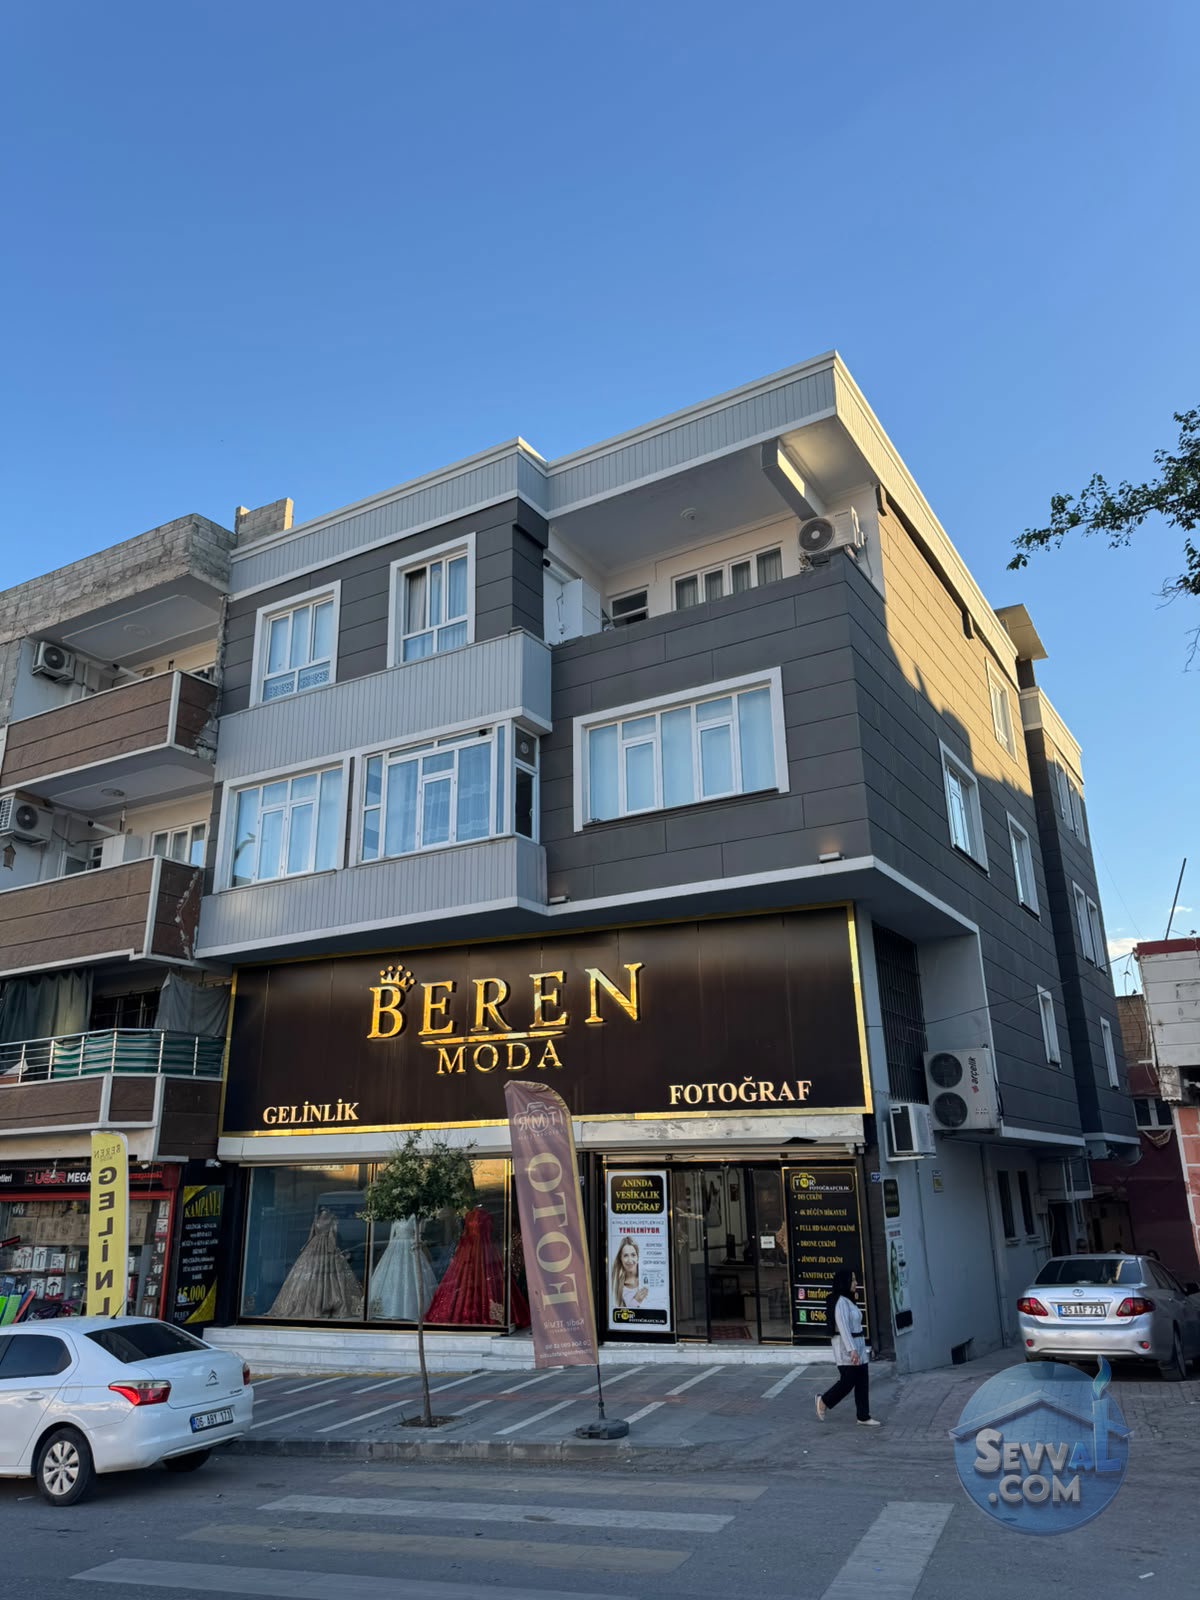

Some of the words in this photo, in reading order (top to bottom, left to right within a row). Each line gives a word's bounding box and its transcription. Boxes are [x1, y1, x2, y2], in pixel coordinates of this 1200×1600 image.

[366, 962, 643, 1039] BEREN
[436, 1039, 563, 1075] MODA
[669, 1076, 812, 1105] FOTOĞRAF
[262, 1099, 360, 1126] GELİNLİK
[615, 1189, 660, 1200] VESİKALIK
[621, 1179, 653, 1188] ANINDA
[616, 1201, 661, 1212] FOTOĞRAF
